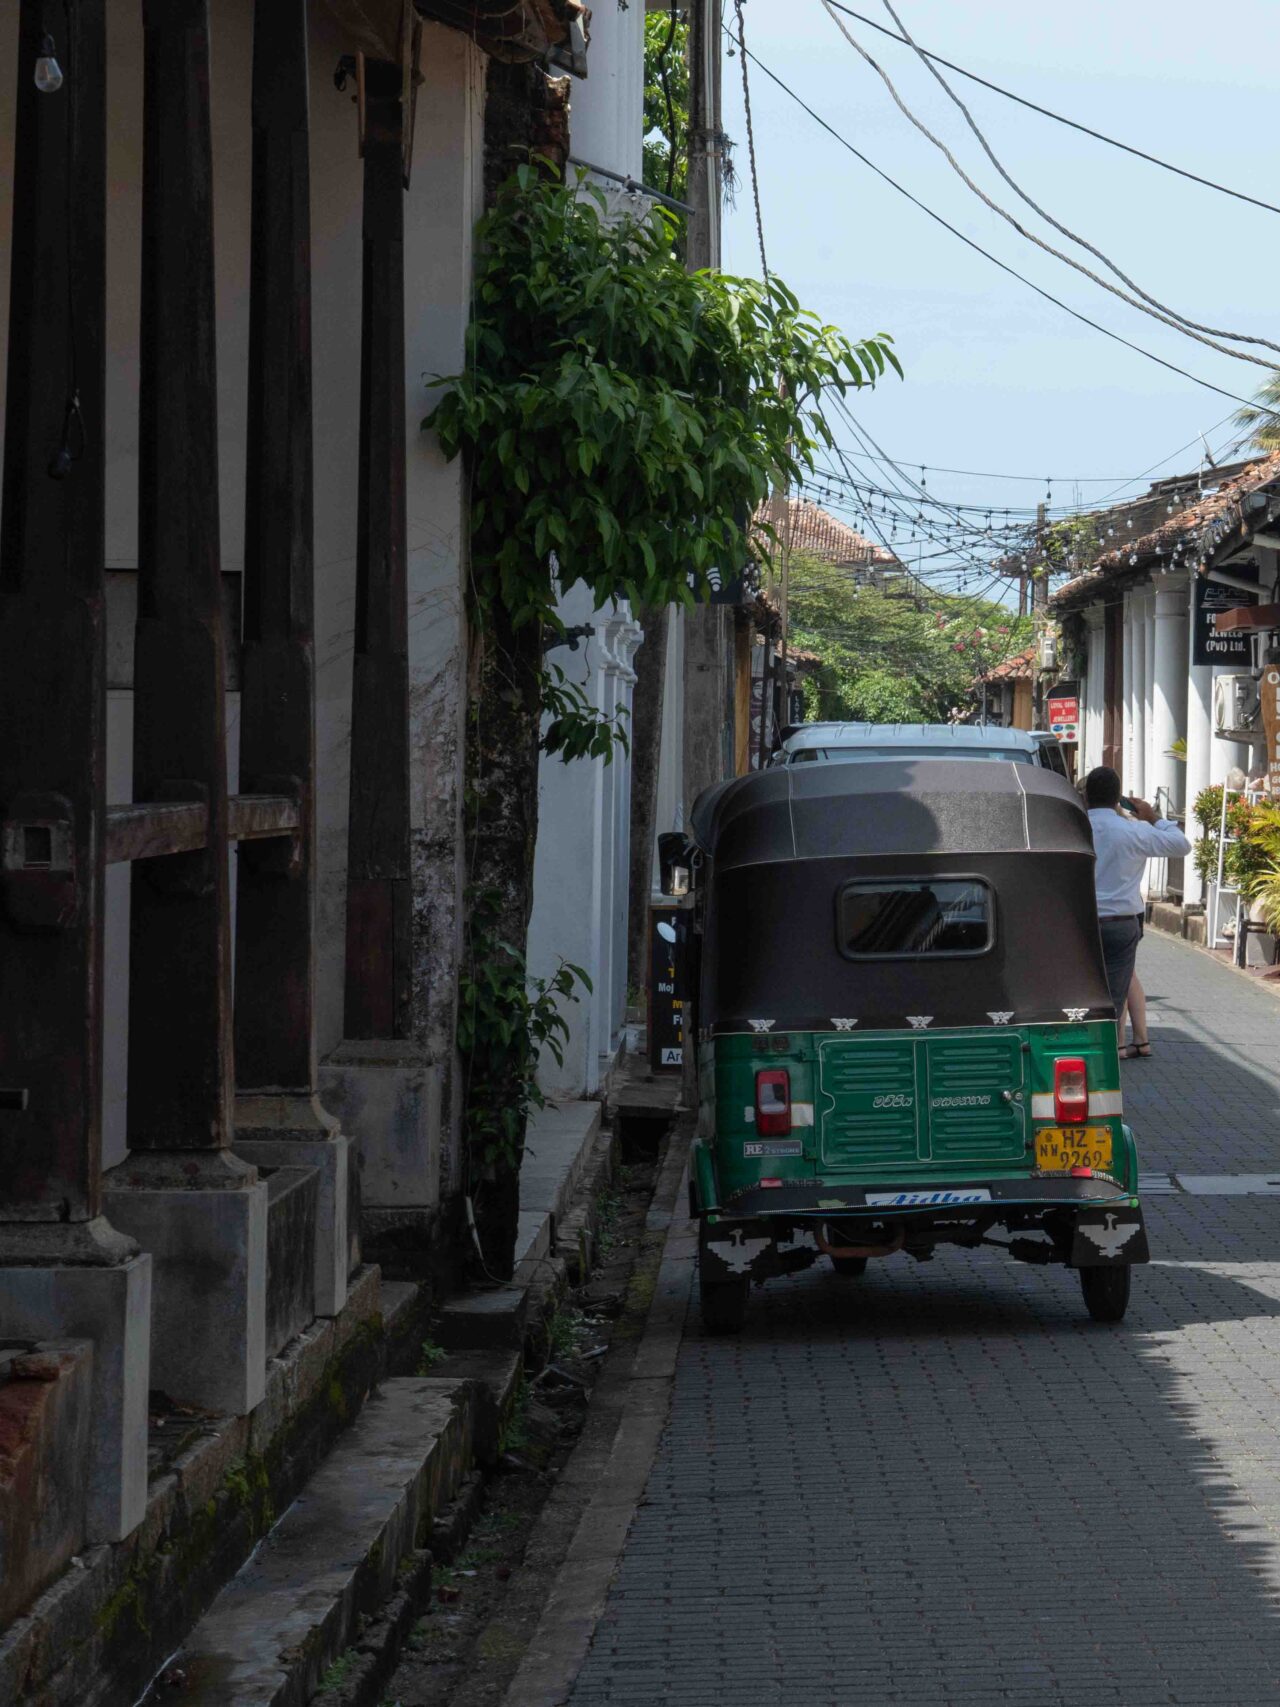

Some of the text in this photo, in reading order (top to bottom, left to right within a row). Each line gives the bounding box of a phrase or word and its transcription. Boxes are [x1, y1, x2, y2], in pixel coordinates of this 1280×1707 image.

[1062, 1130, 1088, 1148] HZ
[745, 1144, 763, 1155] RE
[1060, 1150, 1102, 1169] 9269
